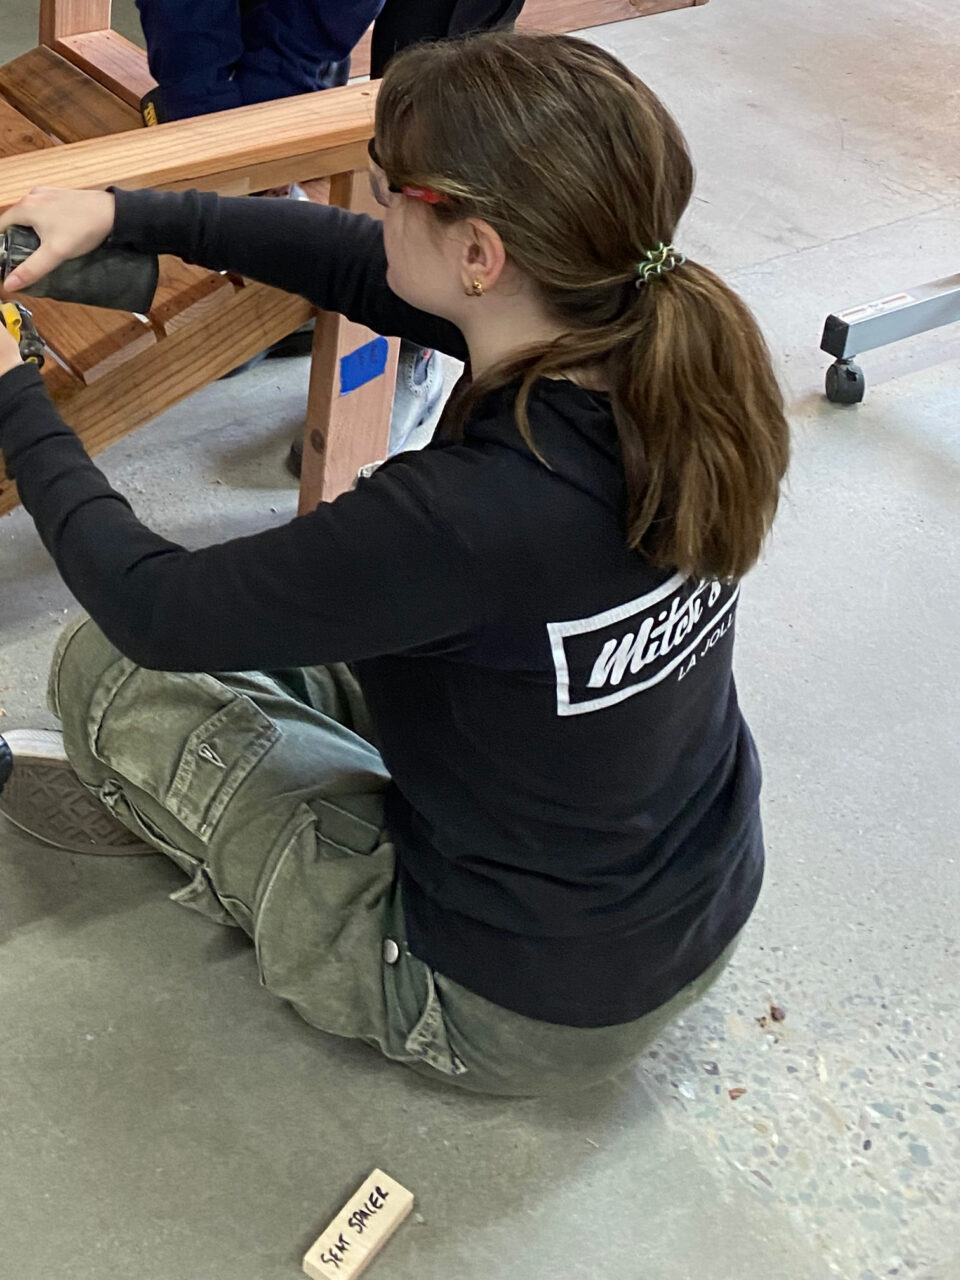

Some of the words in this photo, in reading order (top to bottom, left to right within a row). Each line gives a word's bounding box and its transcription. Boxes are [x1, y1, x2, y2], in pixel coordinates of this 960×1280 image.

[676, 653, 697, 682] LA
[700, 613, 733, 658] JOLL
[348, 1185, 390, 1235] SPACER
